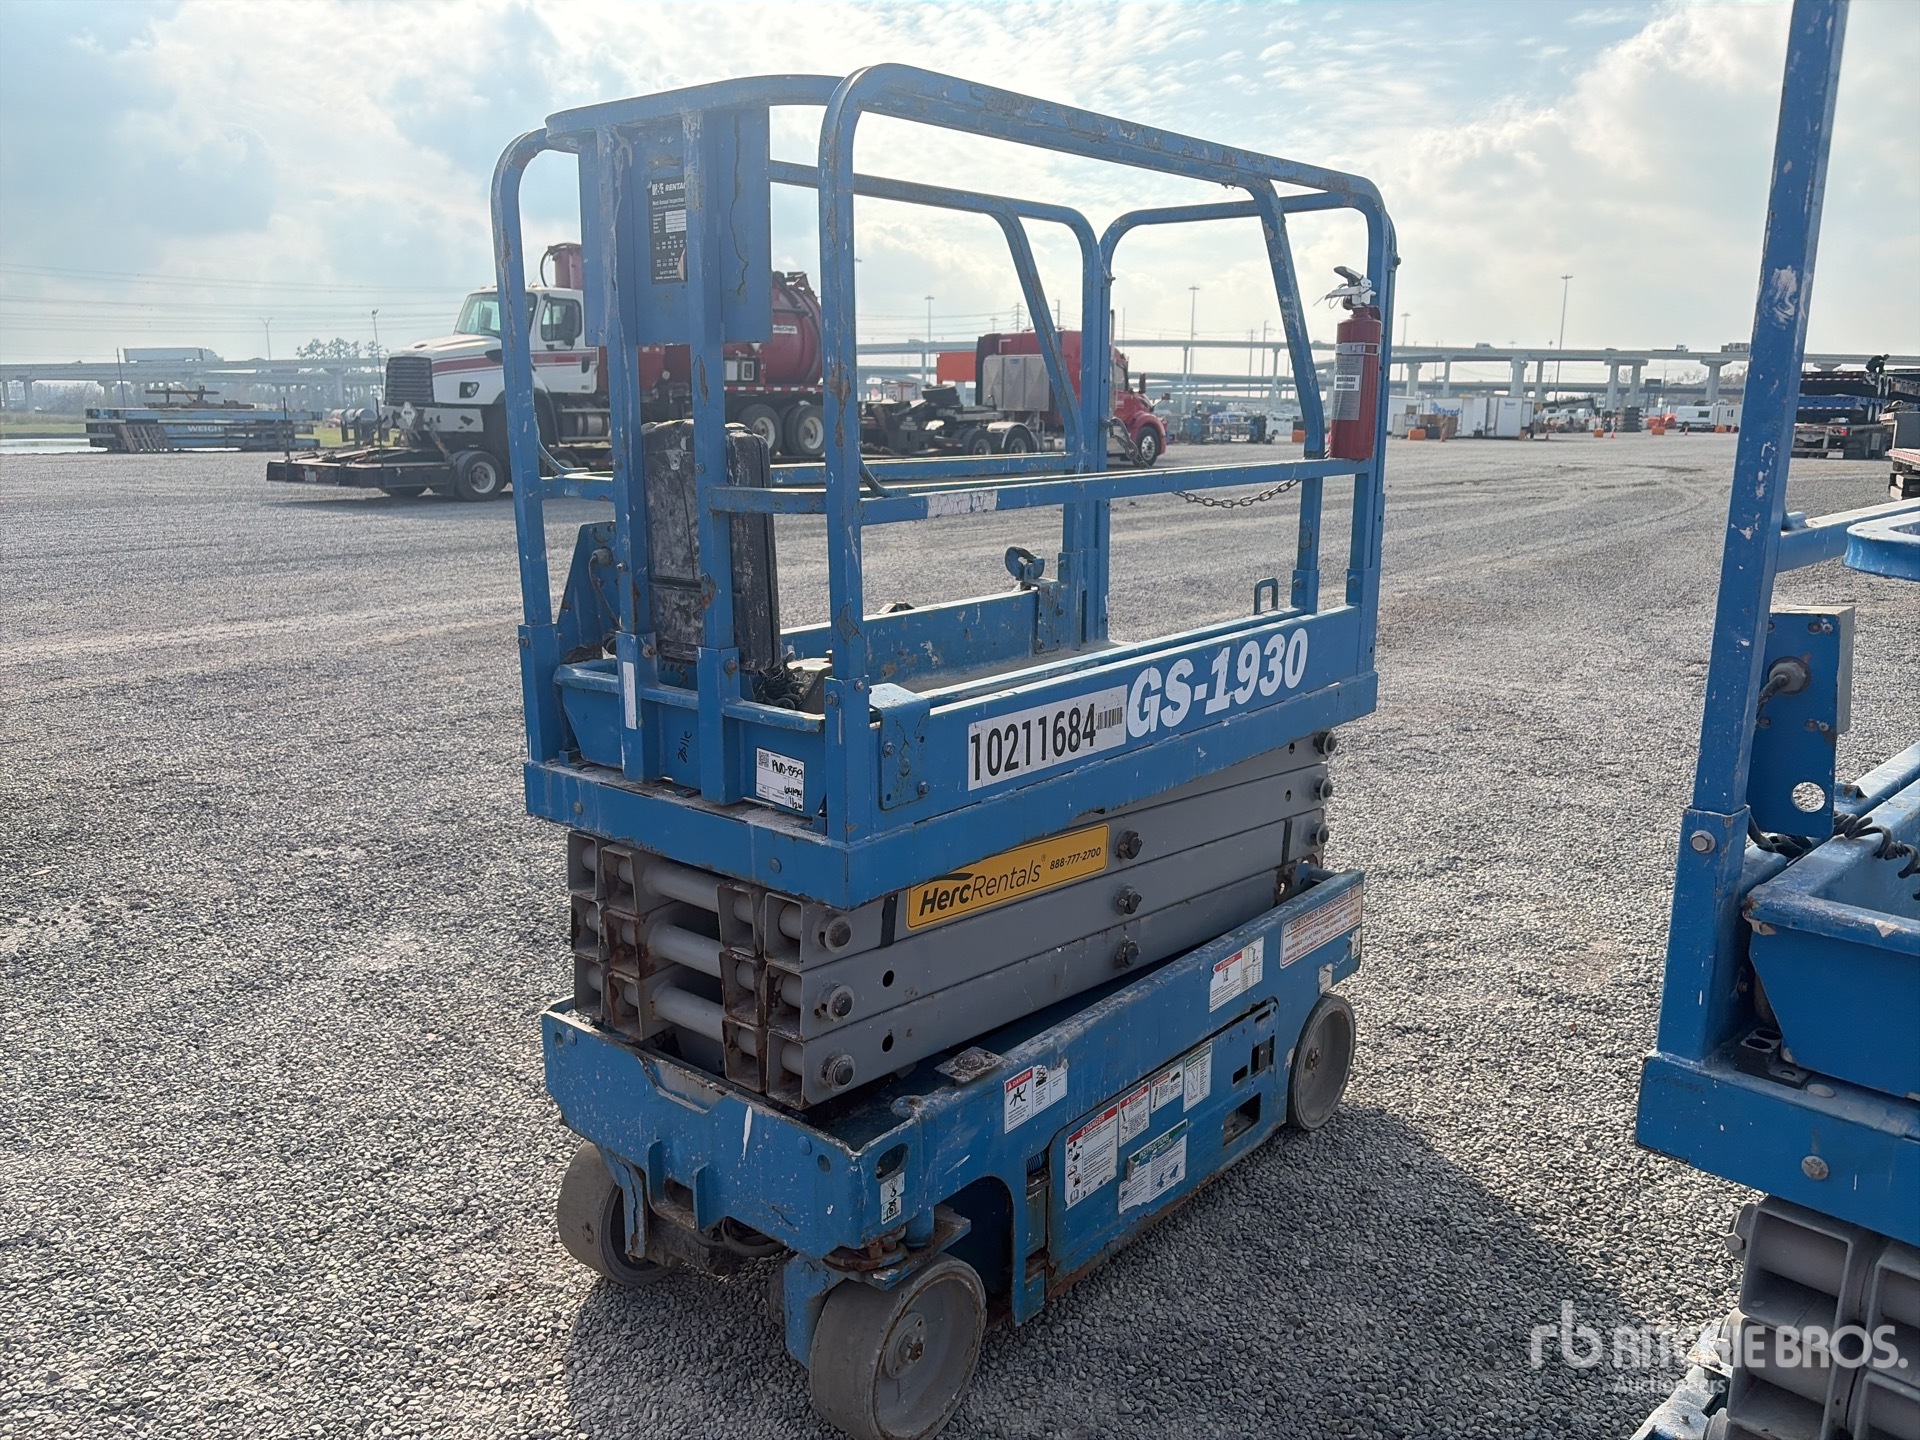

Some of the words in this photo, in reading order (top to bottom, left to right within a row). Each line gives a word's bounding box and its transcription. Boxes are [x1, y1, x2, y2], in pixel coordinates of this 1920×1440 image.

[1127, 628, 1308, 738] GS-1930
[970, 704, 1096, 781] 10211684
[1049, 847, 1101, 870] 888-777-2700
[1290, 909, 1319, 931] CUSTOMER
[1319, 888, 1356, 915] RESPONSIBILITY
[1012, 1070, 1031, 1086] DANGER
[1085, 1114, 1105, 1132] DANGER
